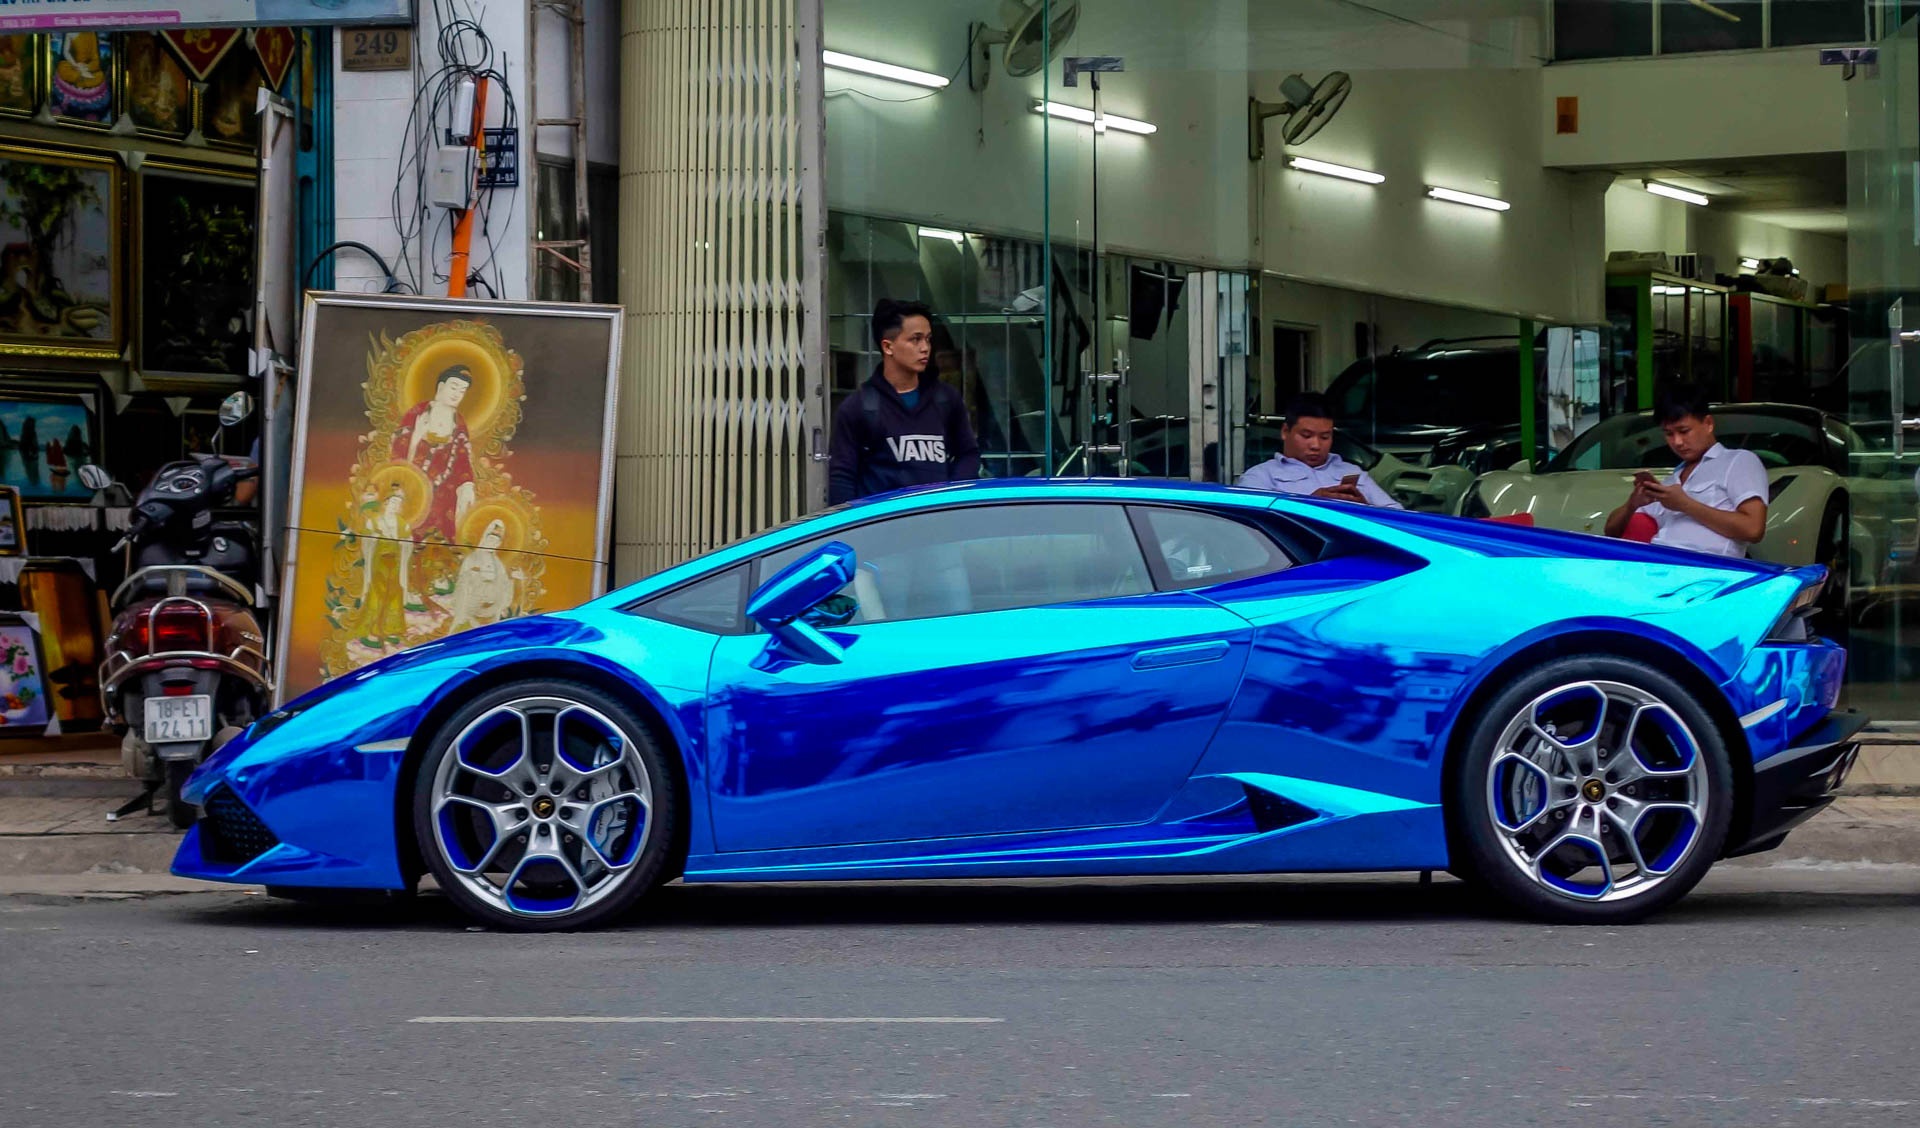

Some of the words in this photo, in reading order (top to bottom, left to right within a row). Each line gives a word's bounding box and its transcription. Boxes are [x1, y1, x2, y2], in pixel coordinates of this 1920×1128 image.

[352, 31, 398, 55] 249
[886, 434, 946, 463] VANS
[156, 699, 199, 718] 18-E1
[151, 719, 206, 739] 124.11
